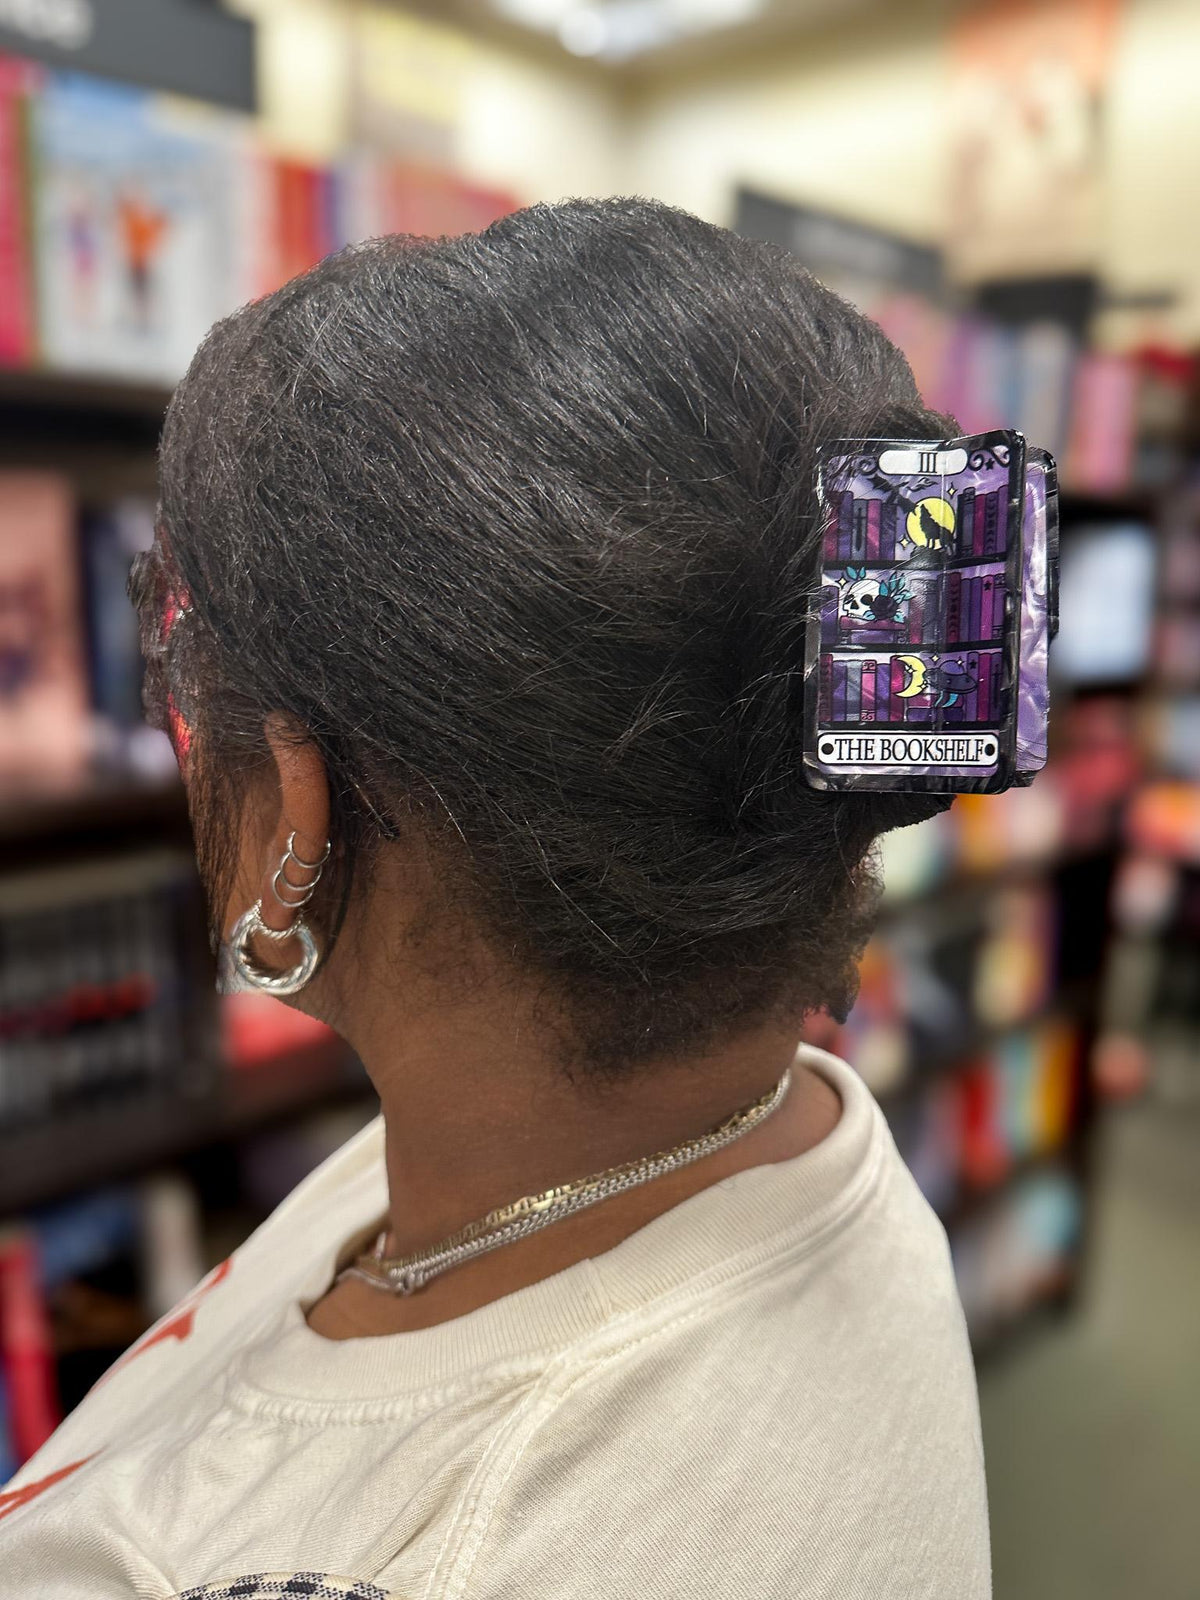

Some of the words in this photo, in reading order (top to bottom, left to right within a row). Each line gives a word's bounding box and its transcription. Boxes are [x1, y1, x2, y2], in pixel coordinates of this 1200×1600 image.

[918, 452, 938, 473] III
[835, 738, 875, 761] THE
[880, 738, 984, 762] BOOKSHELF
